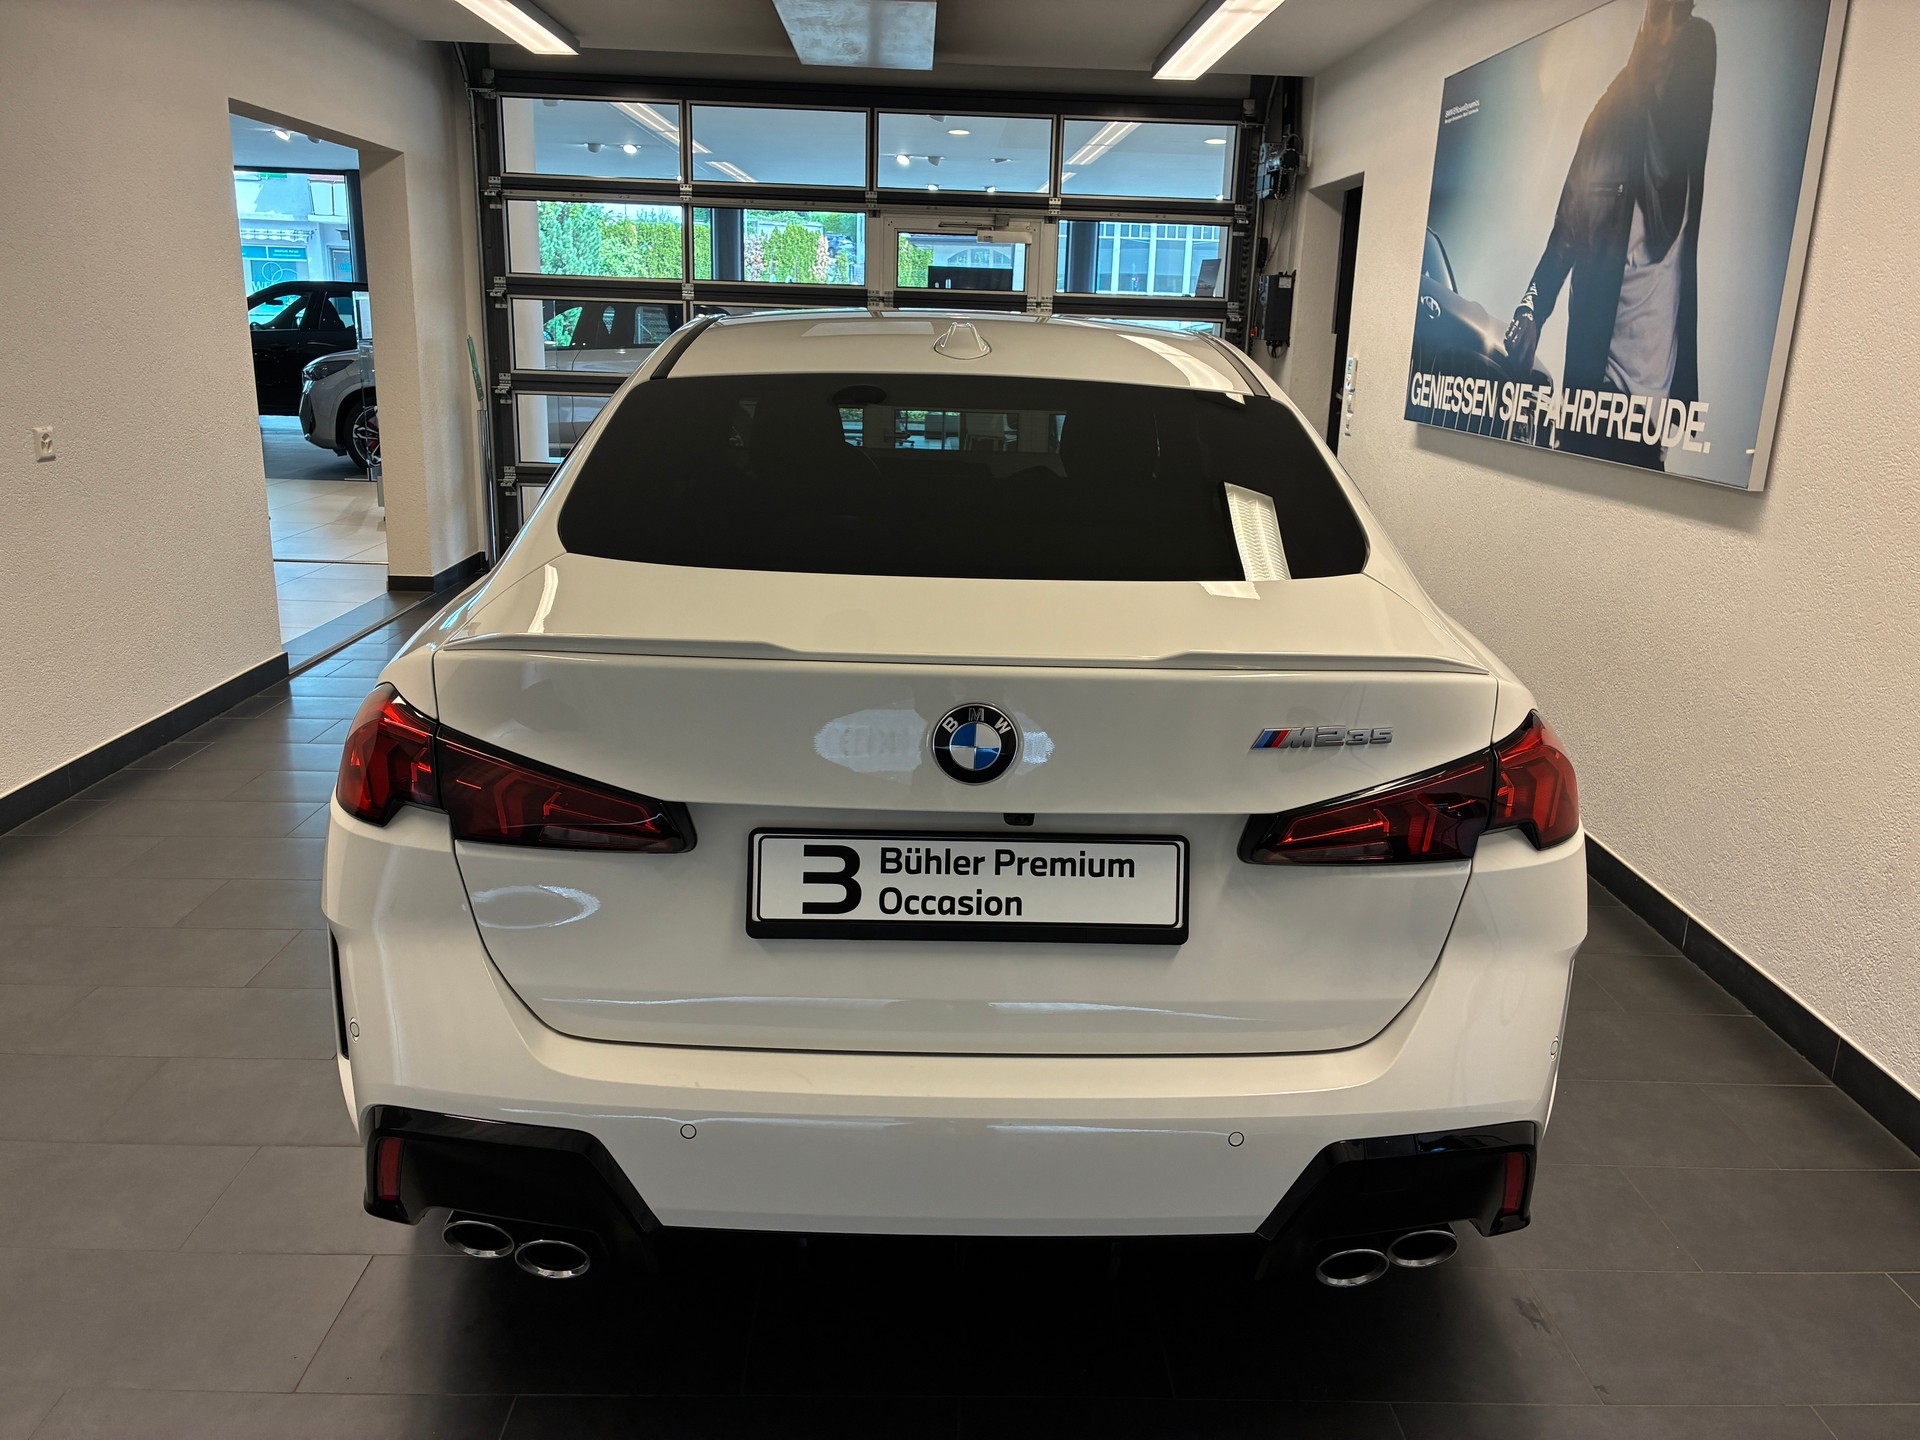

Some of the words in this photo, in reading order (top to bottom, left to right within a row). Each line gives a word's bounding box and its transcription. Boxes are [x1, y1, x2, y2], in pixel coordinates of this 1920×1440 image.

[1411, 371, 1498, 419] GENIESSEN
[1500, 381, 1533, 424] SIE
[1535, 385, 1711, 455] FAHRFREUDE.
[941, 708, 1012, 735] BMW
[1278, 725, 1393, 748] M235
[879, 847, 986, 877] Bühler
[994, 849, 1136, 879] Premium
[878, 886, 1023, 917] Occasion
